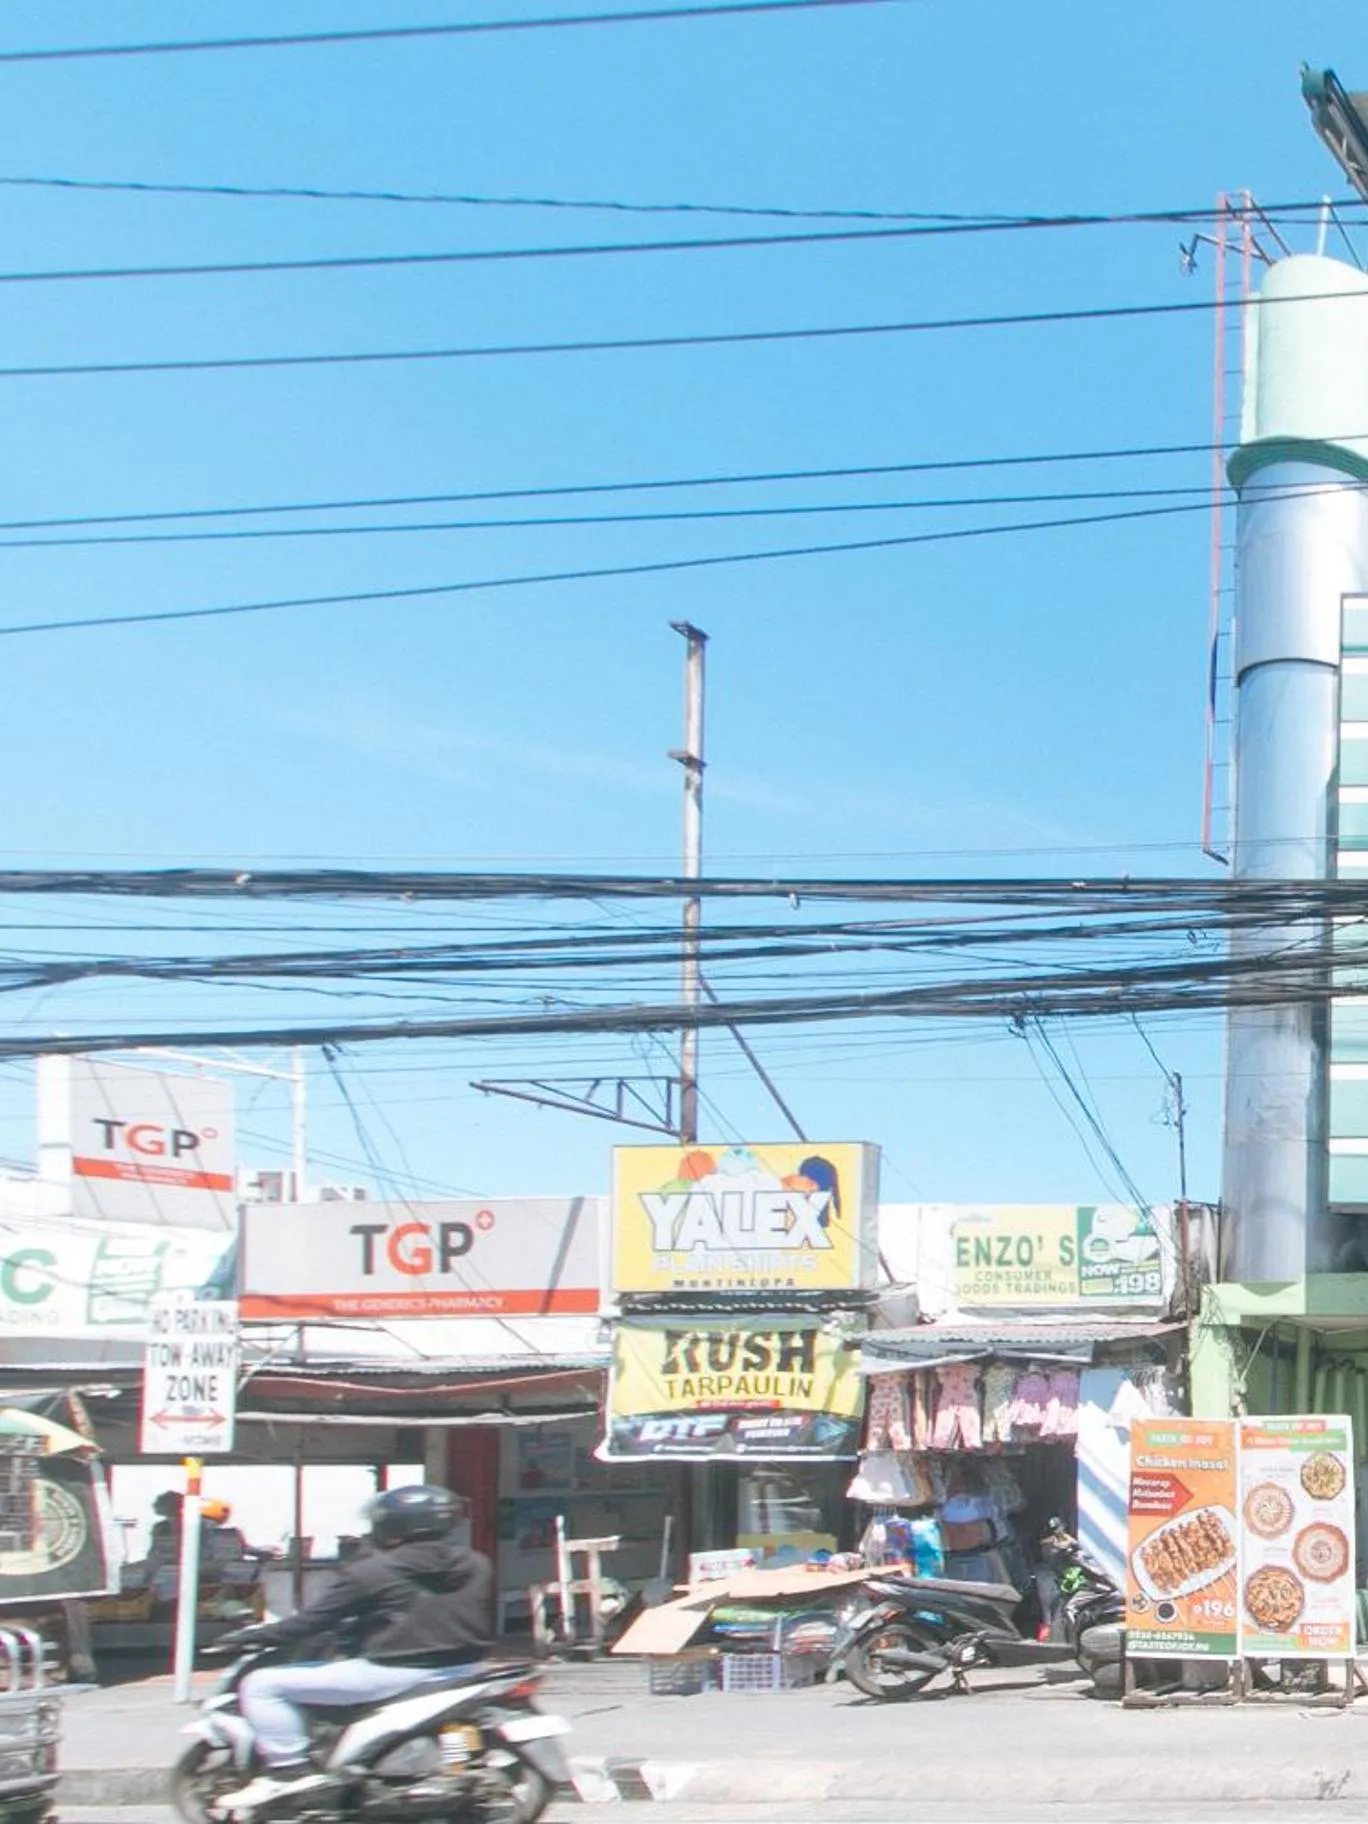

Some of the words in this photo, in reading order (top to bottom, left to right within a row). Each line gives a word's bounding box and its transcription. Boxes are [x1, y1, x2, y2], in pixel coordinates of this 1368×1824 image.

[91, 1117, 200, 1158] TGP
[637, 1190, 836, 1252] YALEX
[349, 1221, 474, 1276] TGP
[974, 1270, 1052, 1283] CONSUMER
[1118, 1272, 1163, 1294] 198
[150, 1342, 183, 1368] TOW
[191, 1341, 235, 1368] AWAY
[662, 1329, 817, 1374] KUSH
[165, 1375, 219, 1402] ZONE
[665, 1375, 814, 1399] TARPAULIN
